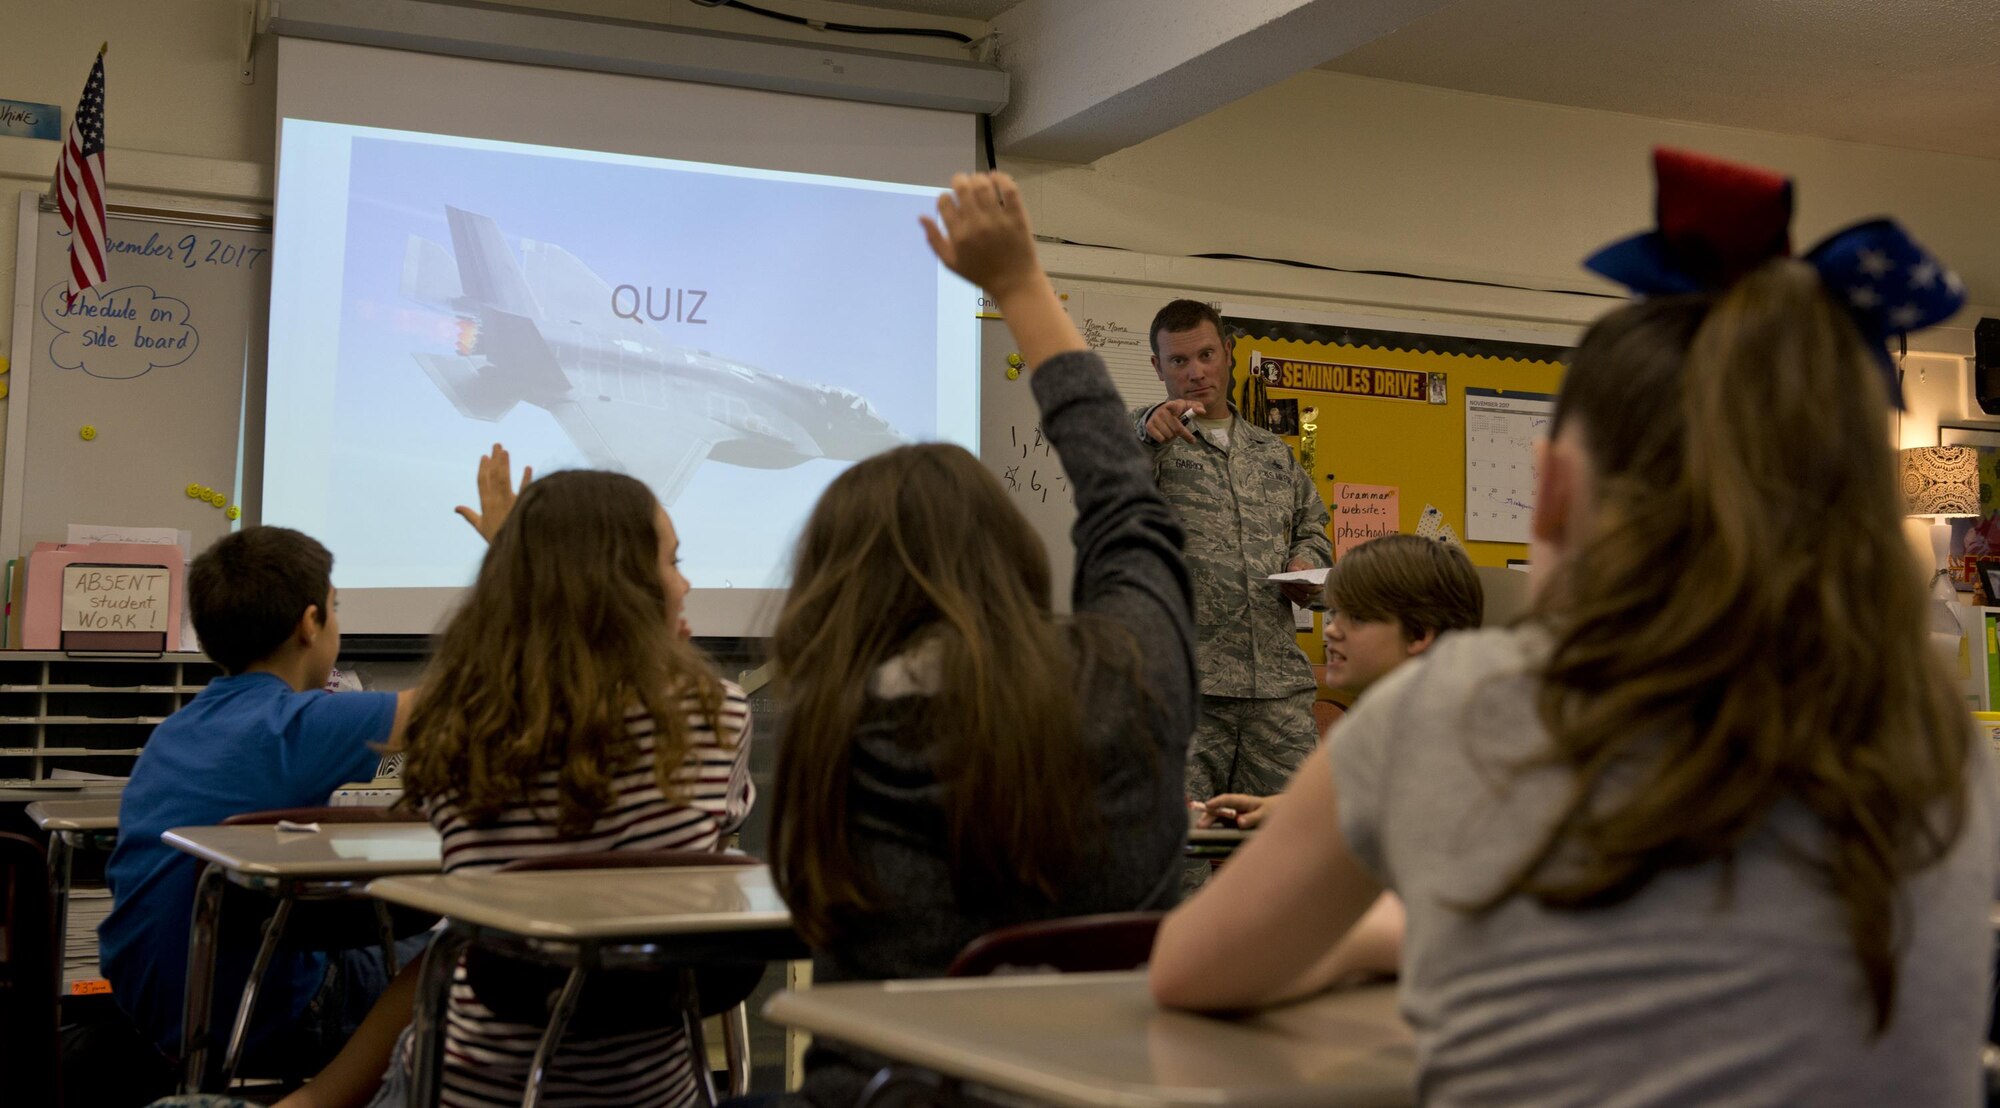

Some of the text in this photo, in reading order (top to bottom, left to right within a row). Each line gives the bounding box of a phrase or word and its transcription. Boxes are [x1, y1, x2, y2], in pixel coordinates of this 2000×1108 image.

[57, 231, 268, 269] vember 9, 2017
[56, 291, 173, 322] Schedule on
[612, 284, 708, 324] QUIZ
[82, 326, 189, 350] side board
[1282, 362, 1419, 397] SEMINOLES DRIVE
[1469, 400, 1498, 408] NOVEMBER
[1341, 485, 1390, 500] Grammar
[75, 572, 162, 593] ABSENT
[90, 594, 156, 609] student
[79, 611, 136, 629] WORK
